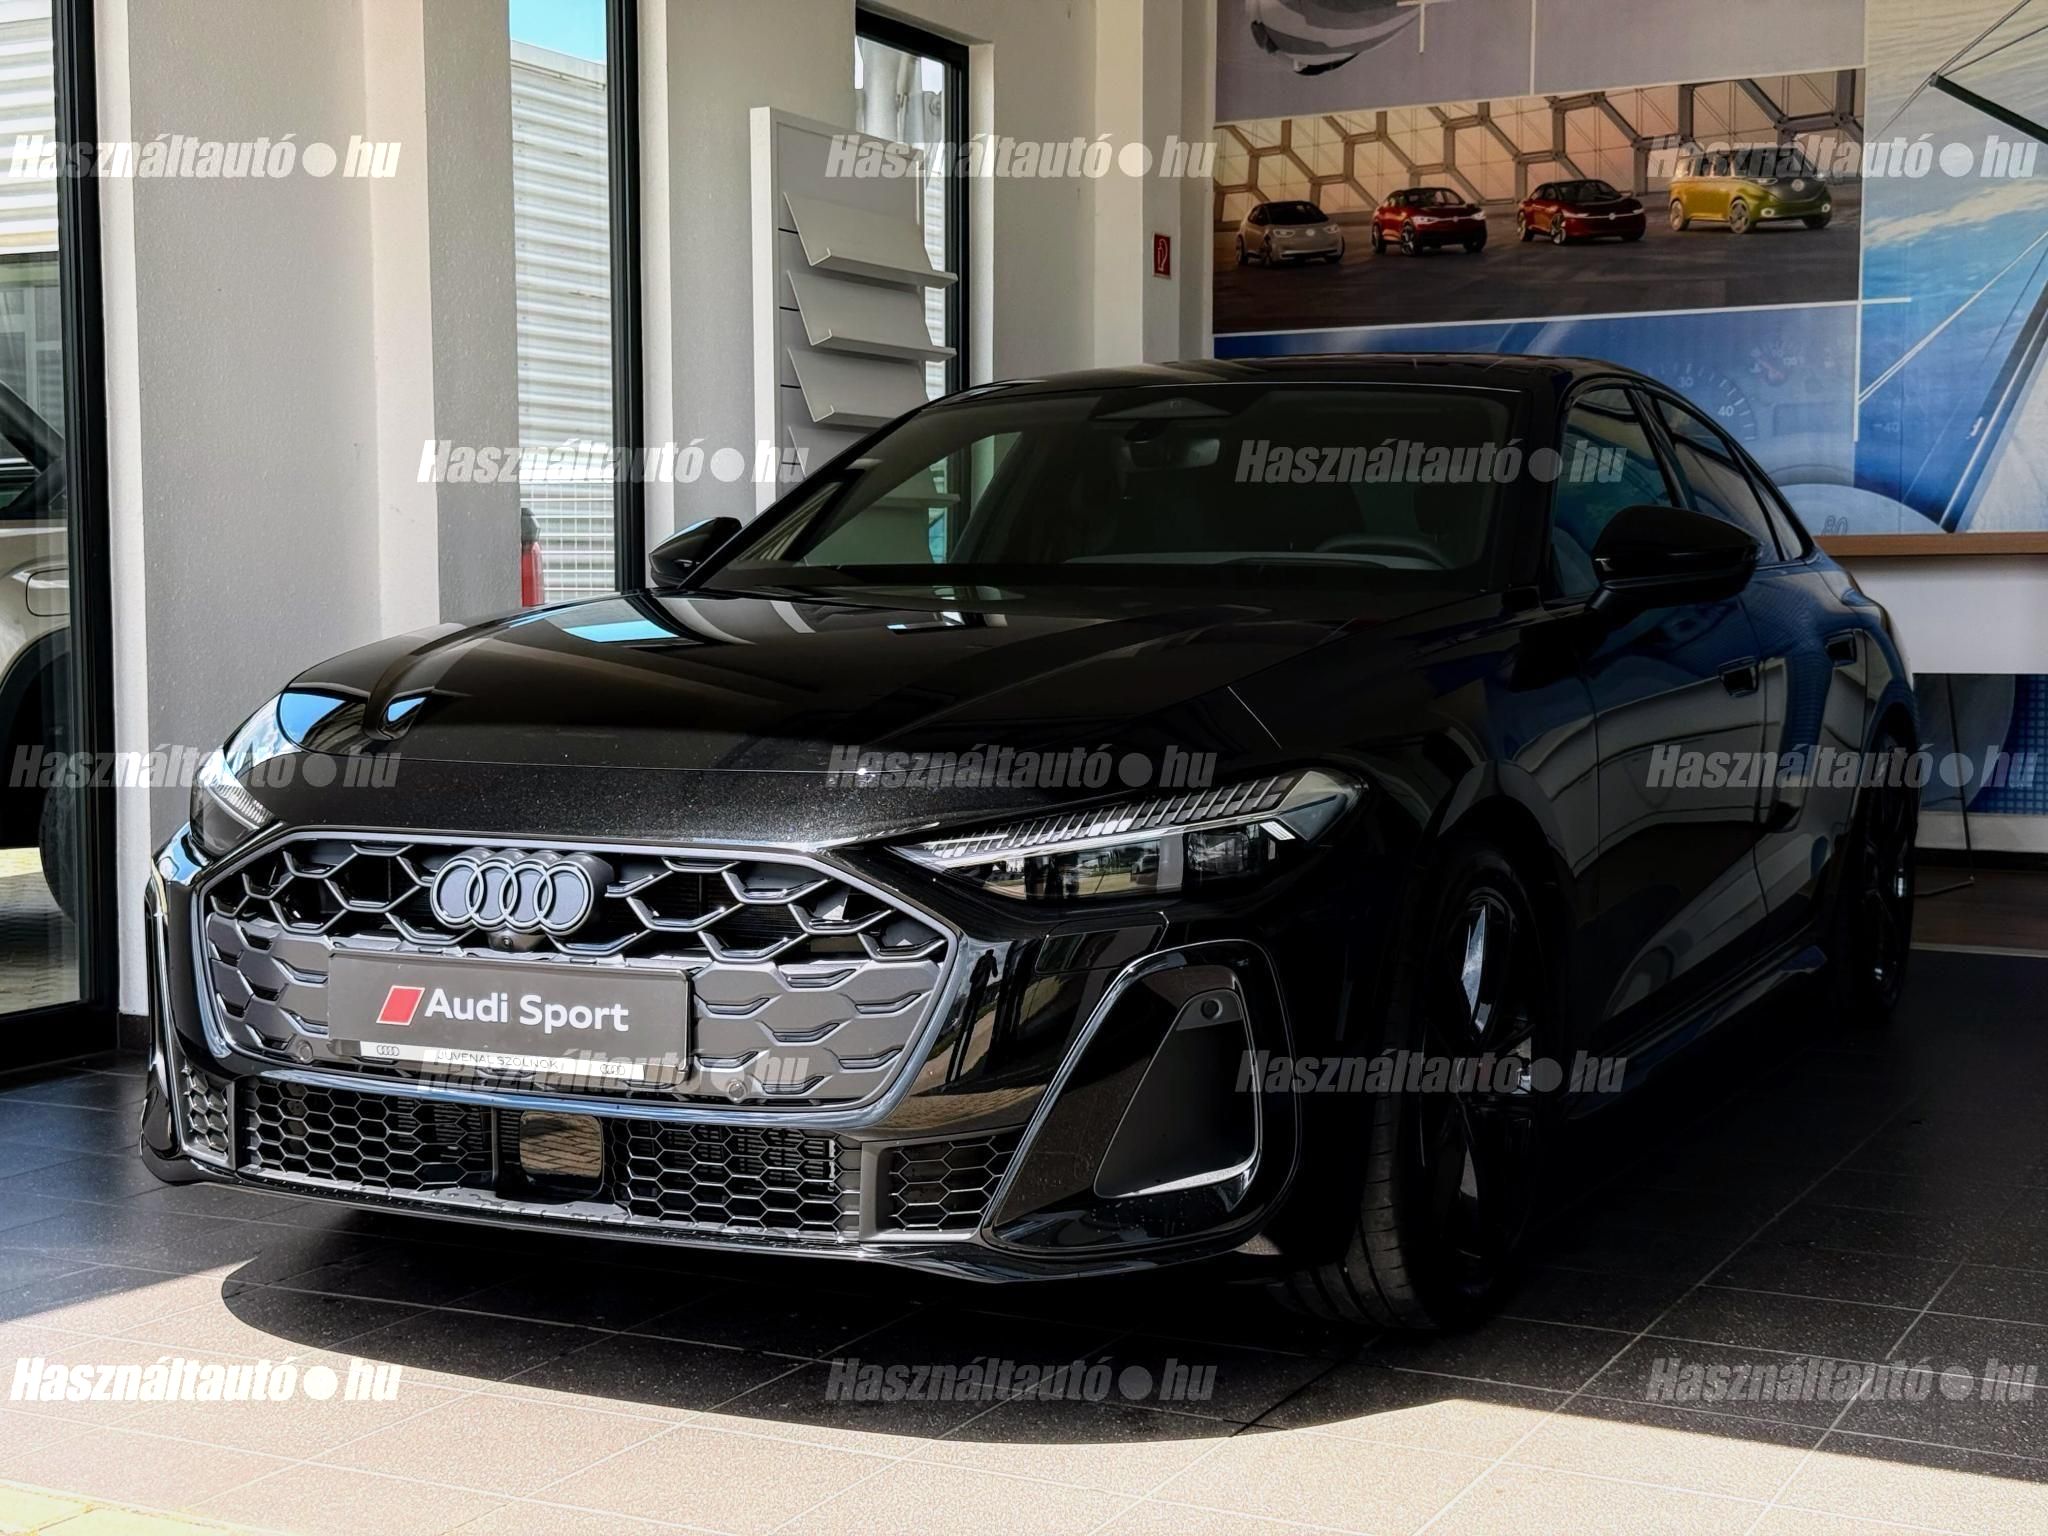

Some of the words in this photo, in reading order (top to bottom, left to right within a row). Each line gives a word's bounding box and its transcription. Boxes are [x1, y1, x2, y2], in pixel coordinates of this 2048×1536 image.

[1718, 404, 1735, 417] 40
[424, 987, 509, 1024] Audi
[518, 993, 630, 1035] Sport
